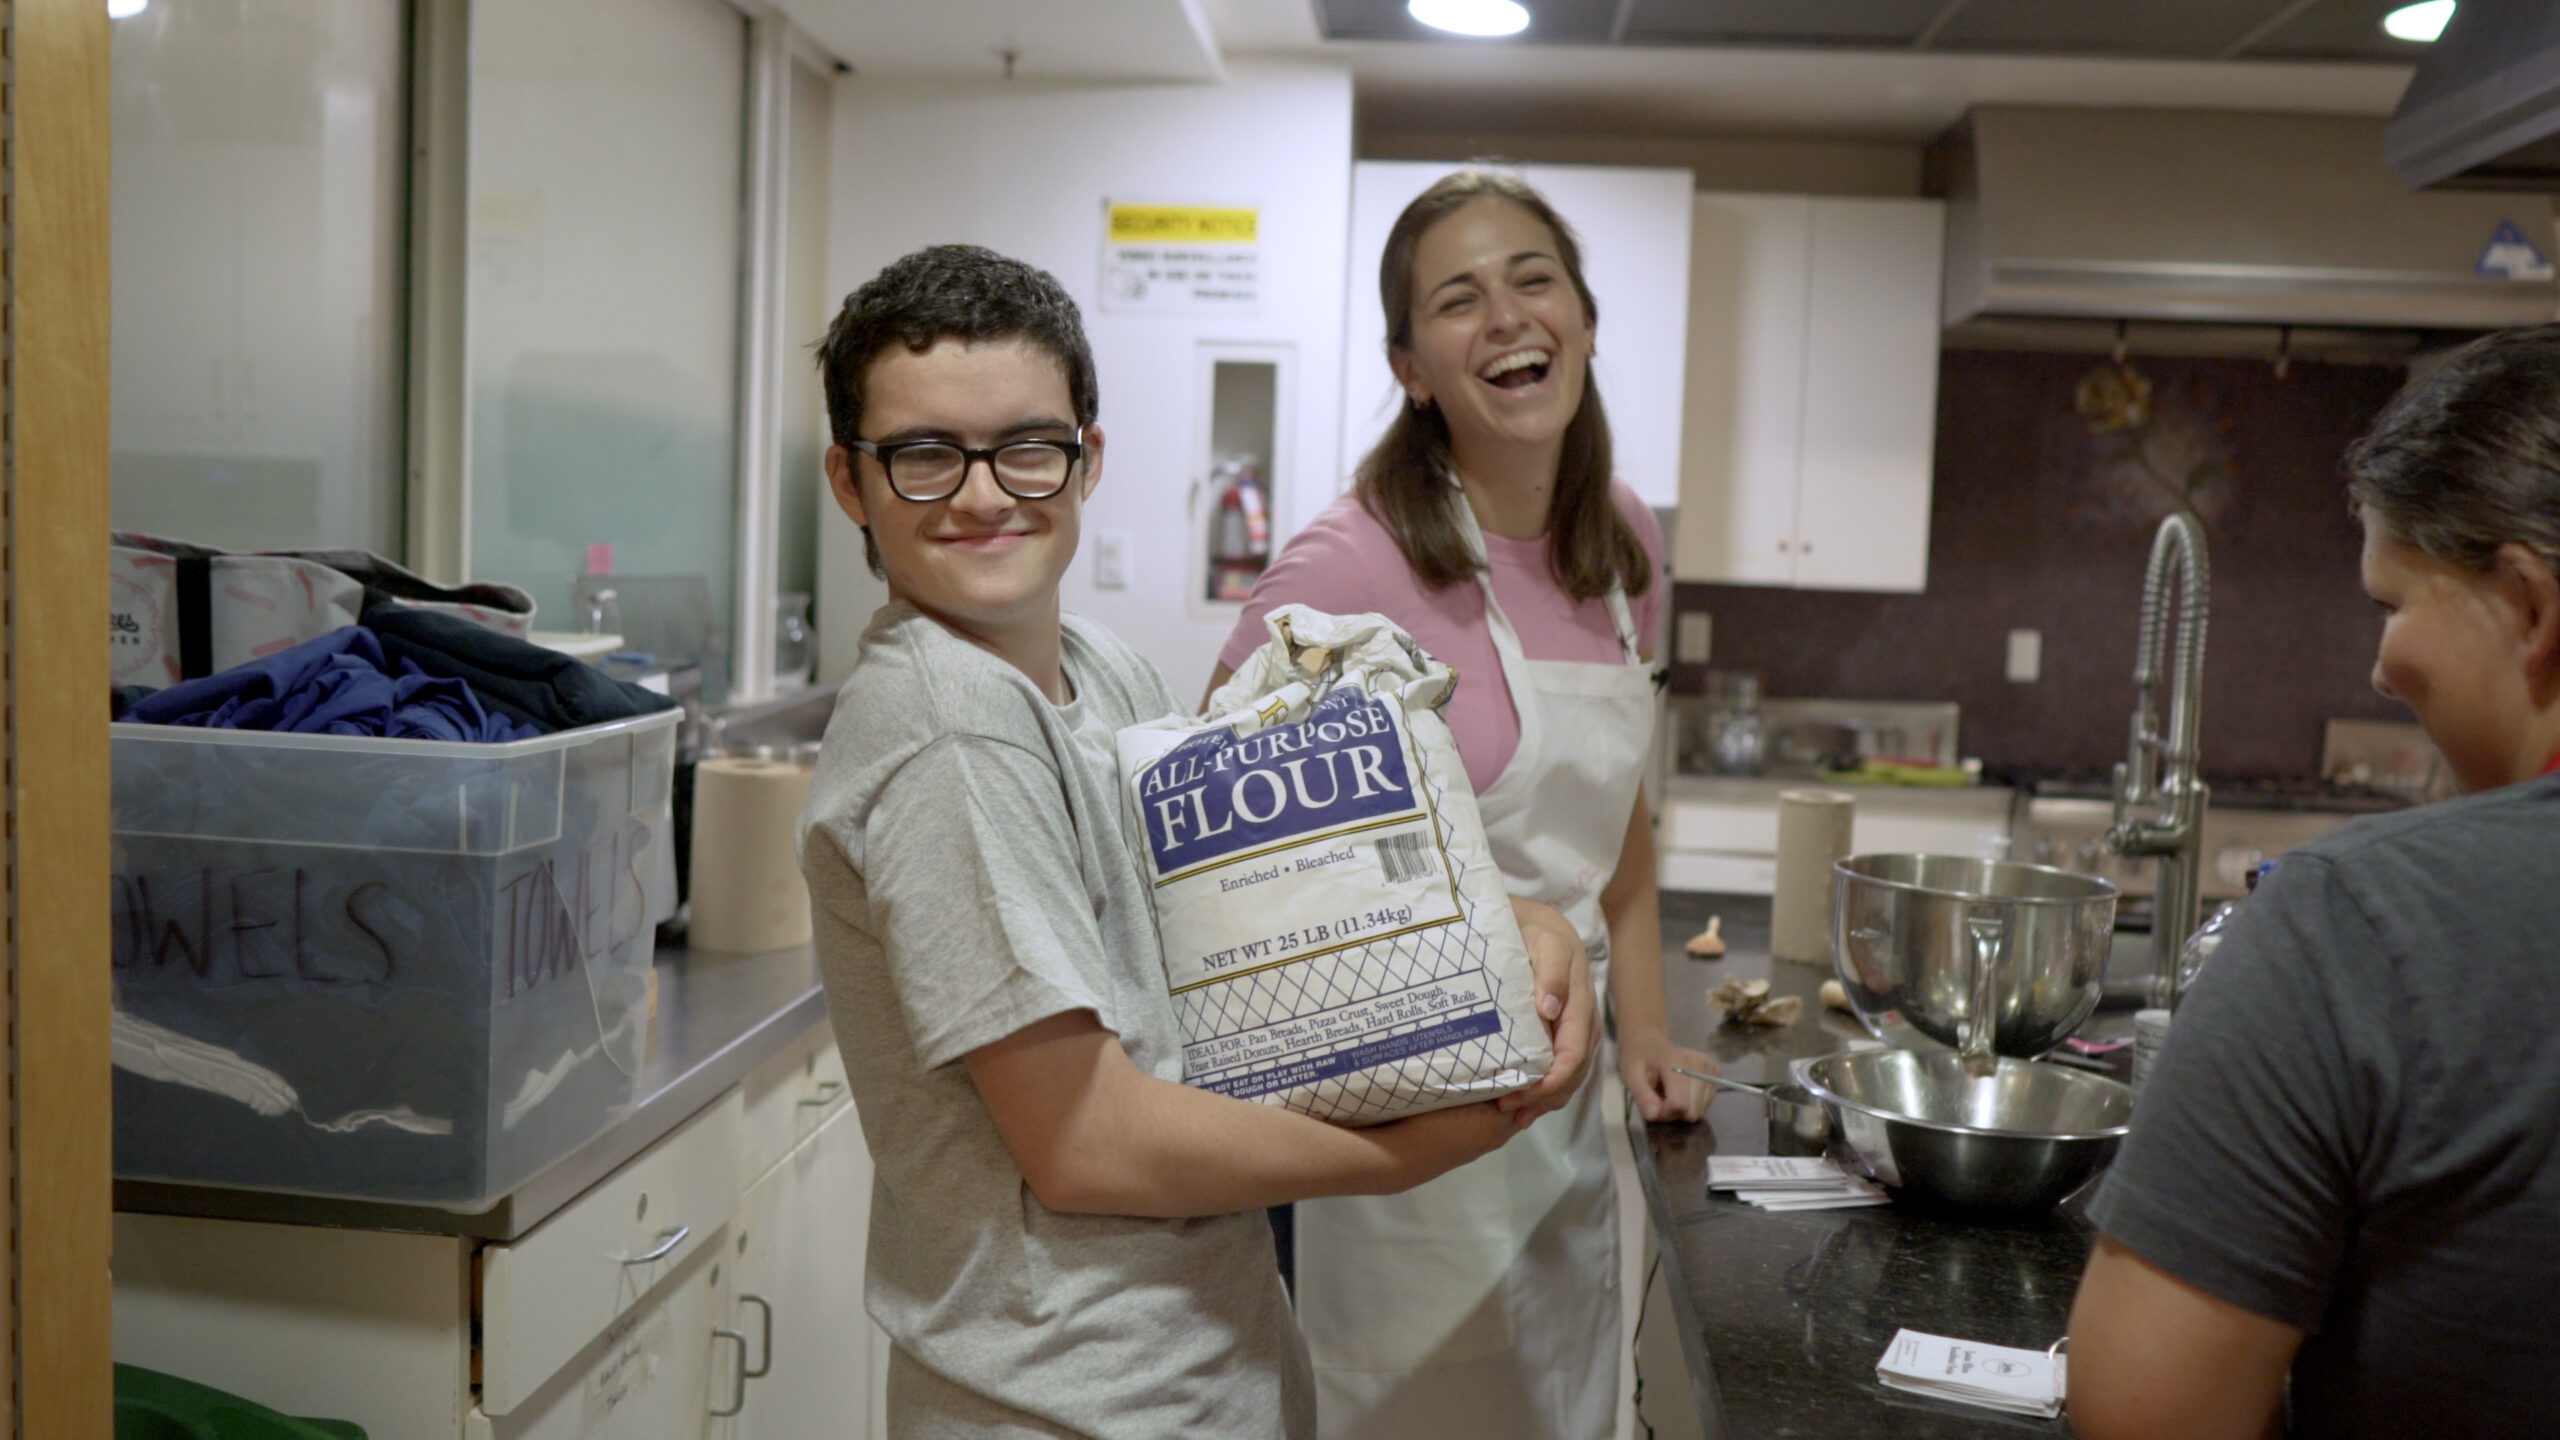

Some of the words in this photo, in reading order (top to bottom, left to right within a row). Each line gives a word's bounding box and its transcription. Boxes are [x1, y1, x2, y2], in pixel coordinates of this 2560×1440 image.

[1144, 706, 1391, 797] ALL-PURPOSE
[1153, 744, 1403, 852] FLOUR
[1219, 866, 1280, 892] Enriched
[1295, 846, 1356, 872] Bleached
[110, 867, 396, 986] OWELS
[500, 825, 647, 998] TOWELS
[1202, 949, 1237, 972] NET
[1241, 939, 1272, 959] WT
[1278, 932, 1299, 952] 25
[1303, 924, 1330, 945] LB
[1334, 904, 1413, 939] (11.34kg)
[1187, 1043, 1219, 1061] IDEAL
[1220, 1037, 1246, 1053] FOR:
[1248, 1033, 1267, 1046] Pan
[1269, 1023, 1307, 1040] Breads,
[1308, 1016, 1337, 1031] Pizza
[1339, 1006, 1374, 1022] Crust,
[1374, 996, 1405, 1013] Sweet
[1406, 985, 1448, 1004] Dough,
[1211, 1053, 1241, 1068] Raised
[1244, 1042, 1285, 1060] Donuts,
[1285, 1033, 1323, 1050] Hearth
[1325, 1023, 1364, 1043] Breads,
[1366, 1013, 1394, 1029] Hard
[1395, 1004, 1428, 1021] Rolls,
[1428, 998, 1450, 1012] Soft
[1352, 1045, 1376, 1059] WASH
[1233, 1078, 1249, 1089] EAT
[1251, 1074, 1264, 1084] OR
[1266, 1068, 1288, 1081] PLAY
[1290, 1063, 1314, 1075] WITH
[1315, 1056, 1336, 1068] RAW
[1233, 1083, 1264, 1097] DOUGH
[1266, 1080, 1279, 1090] OR
[1281, 1071, 1319, 1086] BATTER.
